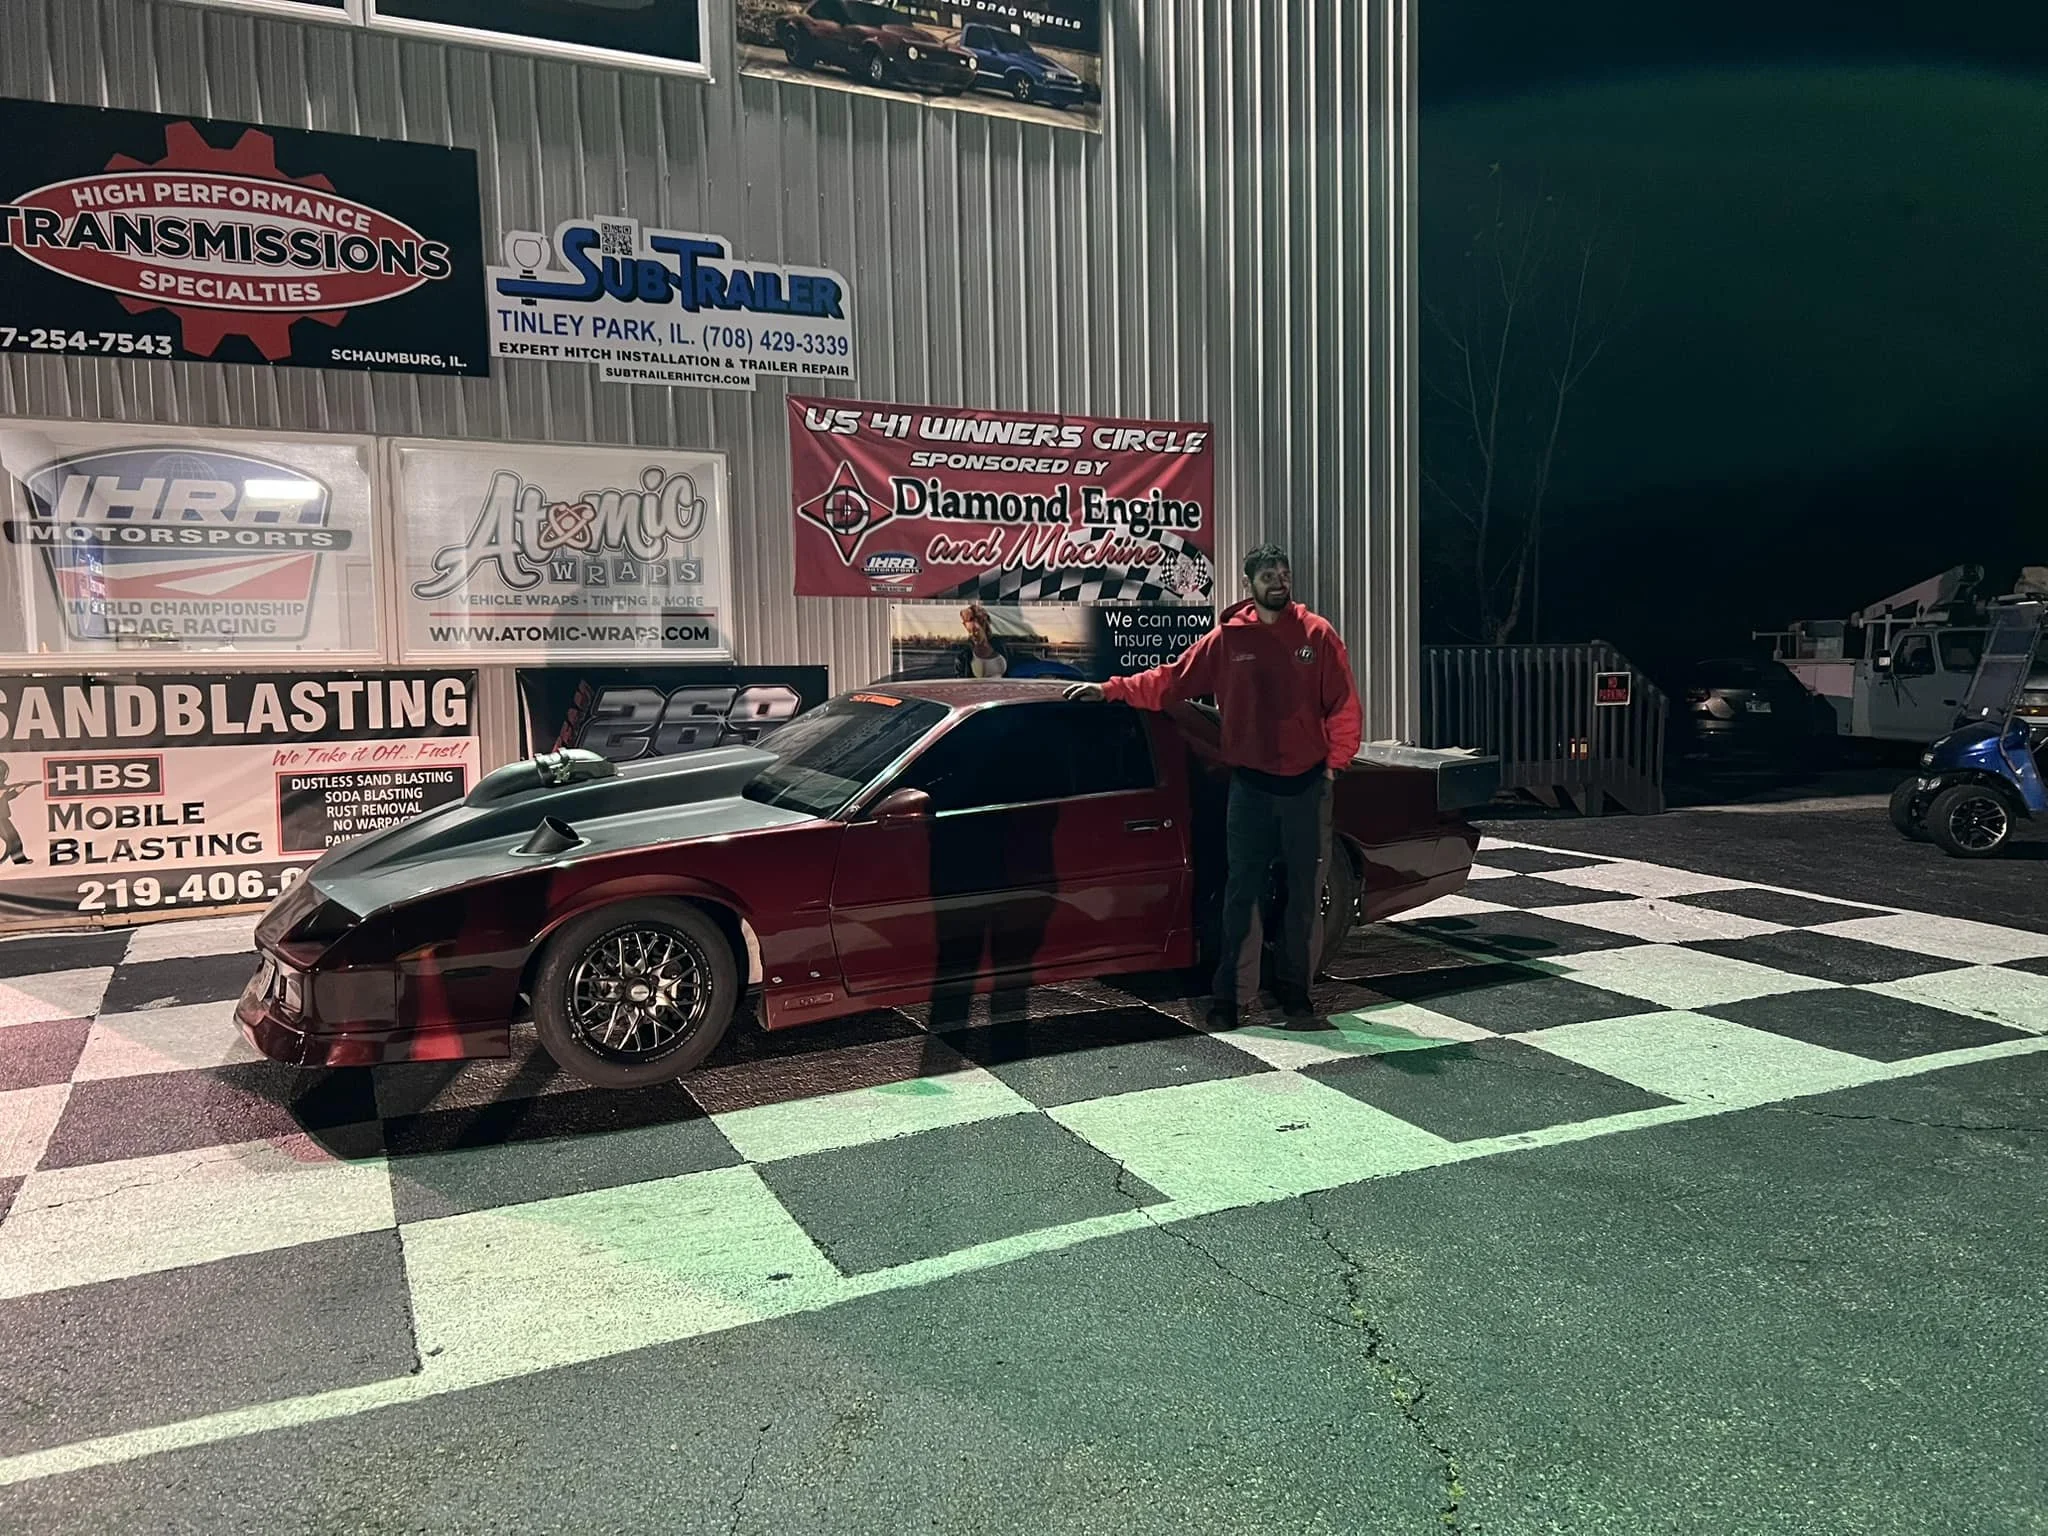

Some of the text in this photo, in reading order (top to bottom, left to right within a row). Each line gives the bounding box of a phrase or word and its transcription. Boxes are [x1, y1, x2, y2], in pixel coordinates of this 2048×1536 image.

[976, 2, 1017, 16] DRAG
[1022, 10, 1081, 29] WHEELS
[72, 183, 371, 233] HIGH PERFORMANCE
[139, 270, 321, 301] SPECIALTIES
[0, 327, 172, 355] 7-254-7543
[497, 310, 848, 356] TINLEY PARK, IL. (708) 429-3339
[331, 349, 467, 368] SCHAUMBURG, IL.
[499, 342, 849, 376] EXPERT HITCH INSTALLATION & TRAILER REPAIR
[606, 367, 750, 385] SUBTRAILERHITCH.COM
[804, 408, 1208, 455] US 41 WINNERS CIRCLE
[909, 452, 1110, 476] SPONSORED BY
[889, 476, 1202, 538] Diamond Engine
[26, 525, 333, 547] MOTORSPORTS
[926, 523, 1168, 571] and Machine
[551, 561, 699, 585] WRAPS
[151, 602, 305, 617] CHAMPIONSHIP
[458, 594, 522, 606] VEHICLE
[525, 595, 578, 606] WRAPS
[591, 595, 647, 607] TINTING
[664, 596, 704, 607] MORE
[183, 618, 277, 635] RACING
[1105, 611, 1211, 628] We can now
[429, 625, 710, 642] WWW.ATOMIC-WRAPS.COM
[1114, 630, 1162, 647] insure
[1120, 651, 1160, 669] drag
[0, 677, 468, 740] ANDBLASTING
[576, 684, 801, 762] 269
[272, 749, 300, 766] We
[304, 747, 347, 765] Take
[351, 746, 368, 761] it
[57, 762, 152, 792] HBS
[291, 771, 453, 790] DUSTLESS SAND BLASTING
[325, 787, 423, 803] SODA BLASTING
[48, 801, 205, 832] MOBILE
[326, 802, 422, 818] RUST REMOVAL
[333, 816, 414, 831] NO WARPA
[48, 831, 263, 867] BLASTING
